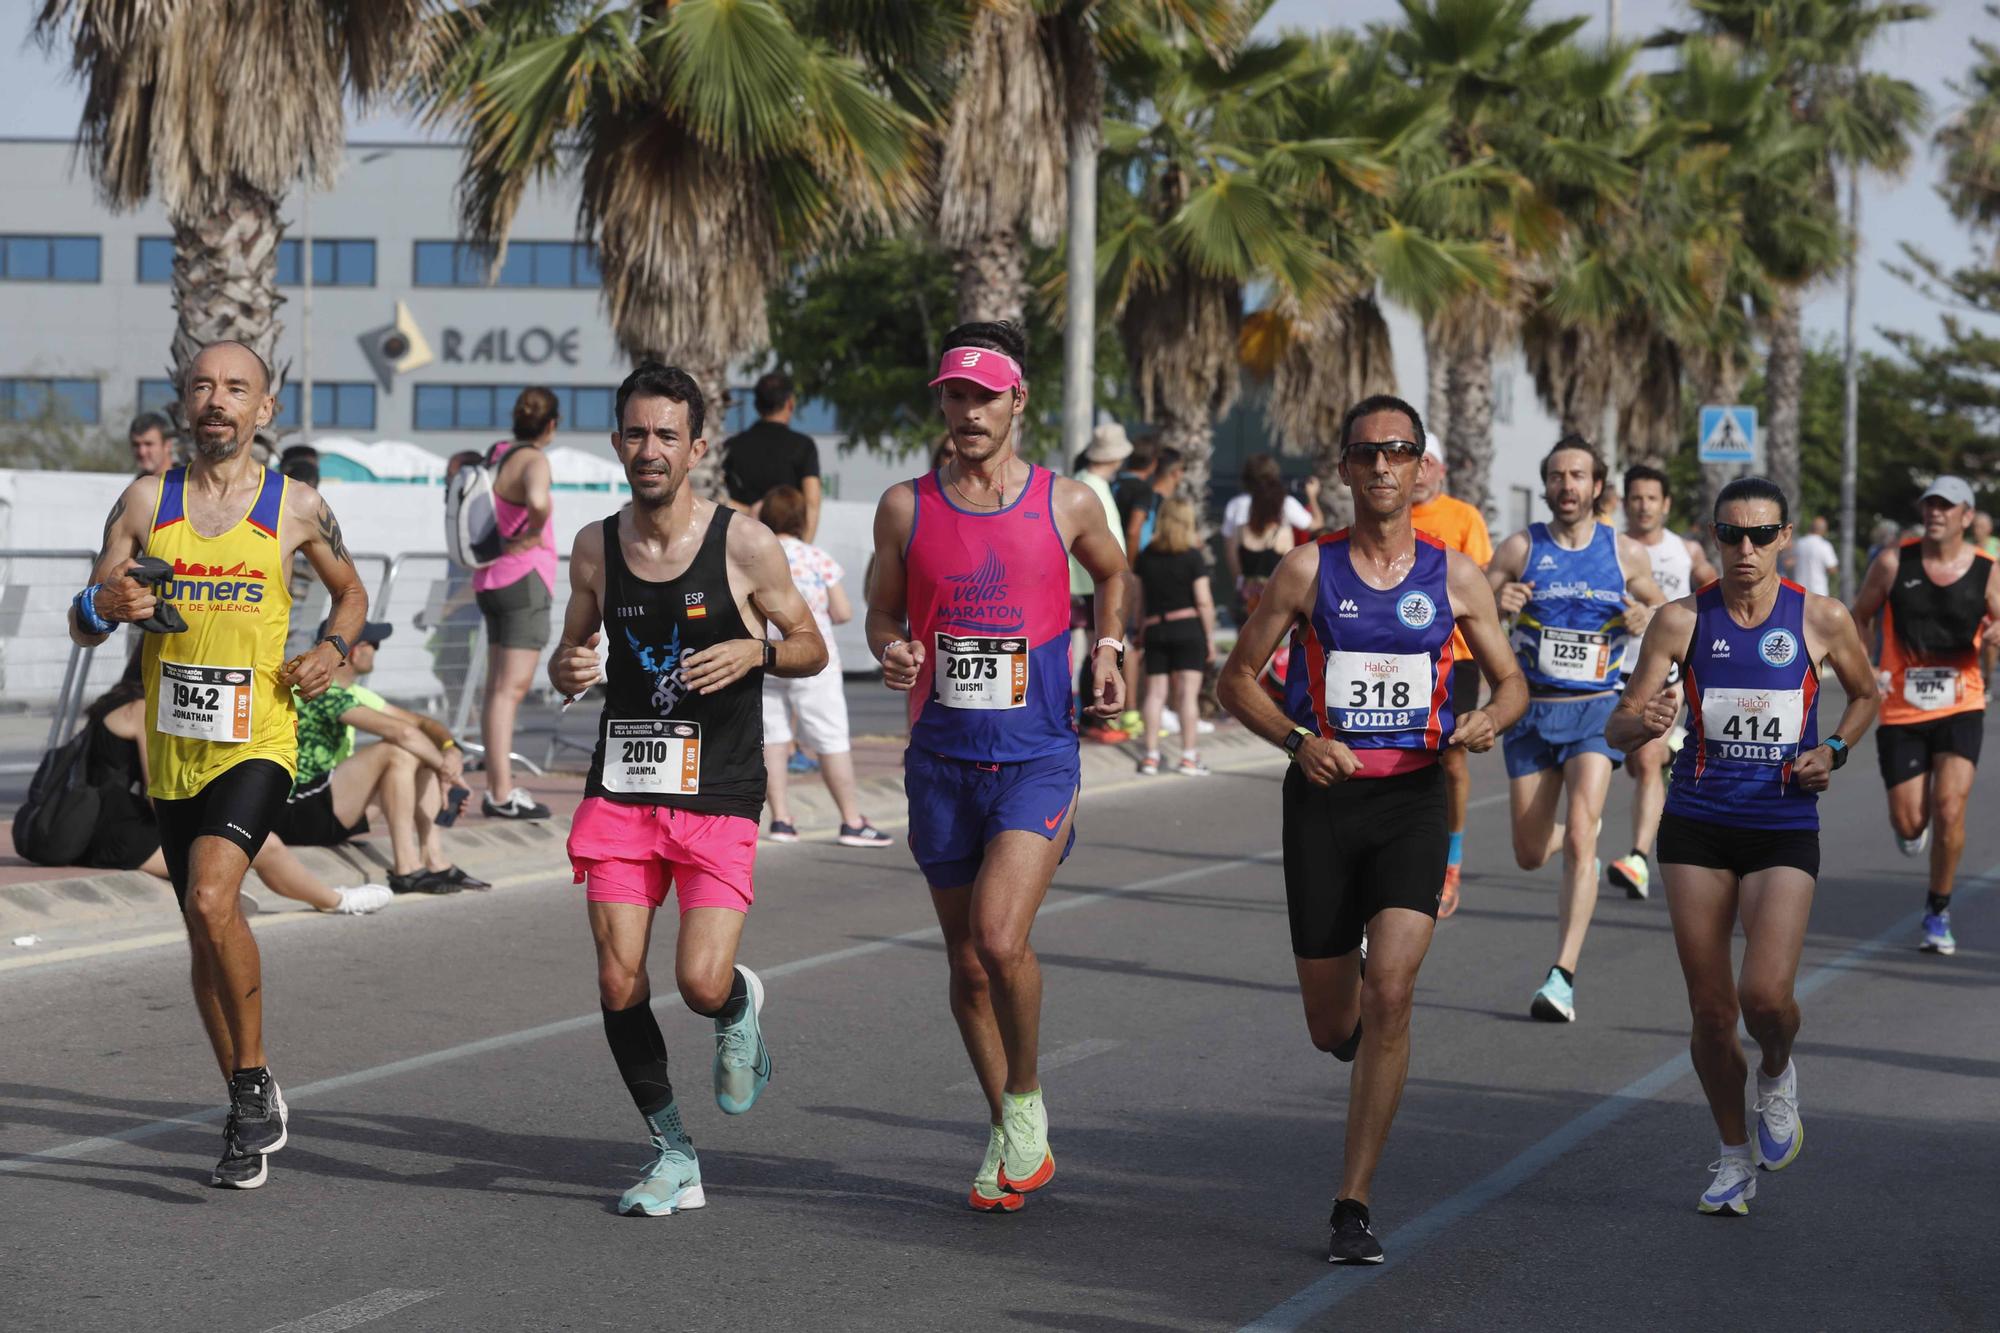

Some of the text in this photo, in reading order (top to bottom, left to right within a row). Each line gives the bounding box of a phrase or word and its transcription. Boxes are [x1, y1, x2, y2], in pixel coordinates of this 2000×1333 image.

[441, 325, 580, 366] RALOE
[155, 579, 264, 603] unners
[685, 592, 704, 605] ESP
[953, 584, 1008, 605] velas
[189, 603, 204, 612] DE
[1554, 643, 1588, 661] 1235
[946, 656, 997, 680] 2073
[1015, 662, 1024, 678] BOX
[955, 682, 983, 692] LUISMI
[1349, 680, 1410, 708] 318
[1915, 680, 1945, 693] 1074
[172, 683, 219, 710] 1942
[238, 695, 247, 711] BOX
[172, 709, 213, 723] JONATHAN
[1722, 715, 1782, 742] 414
[622, 740, 667, 763] 2010
[686, 747, 695, 763] BOX
[626, 766, 656, 775] JUANMA
